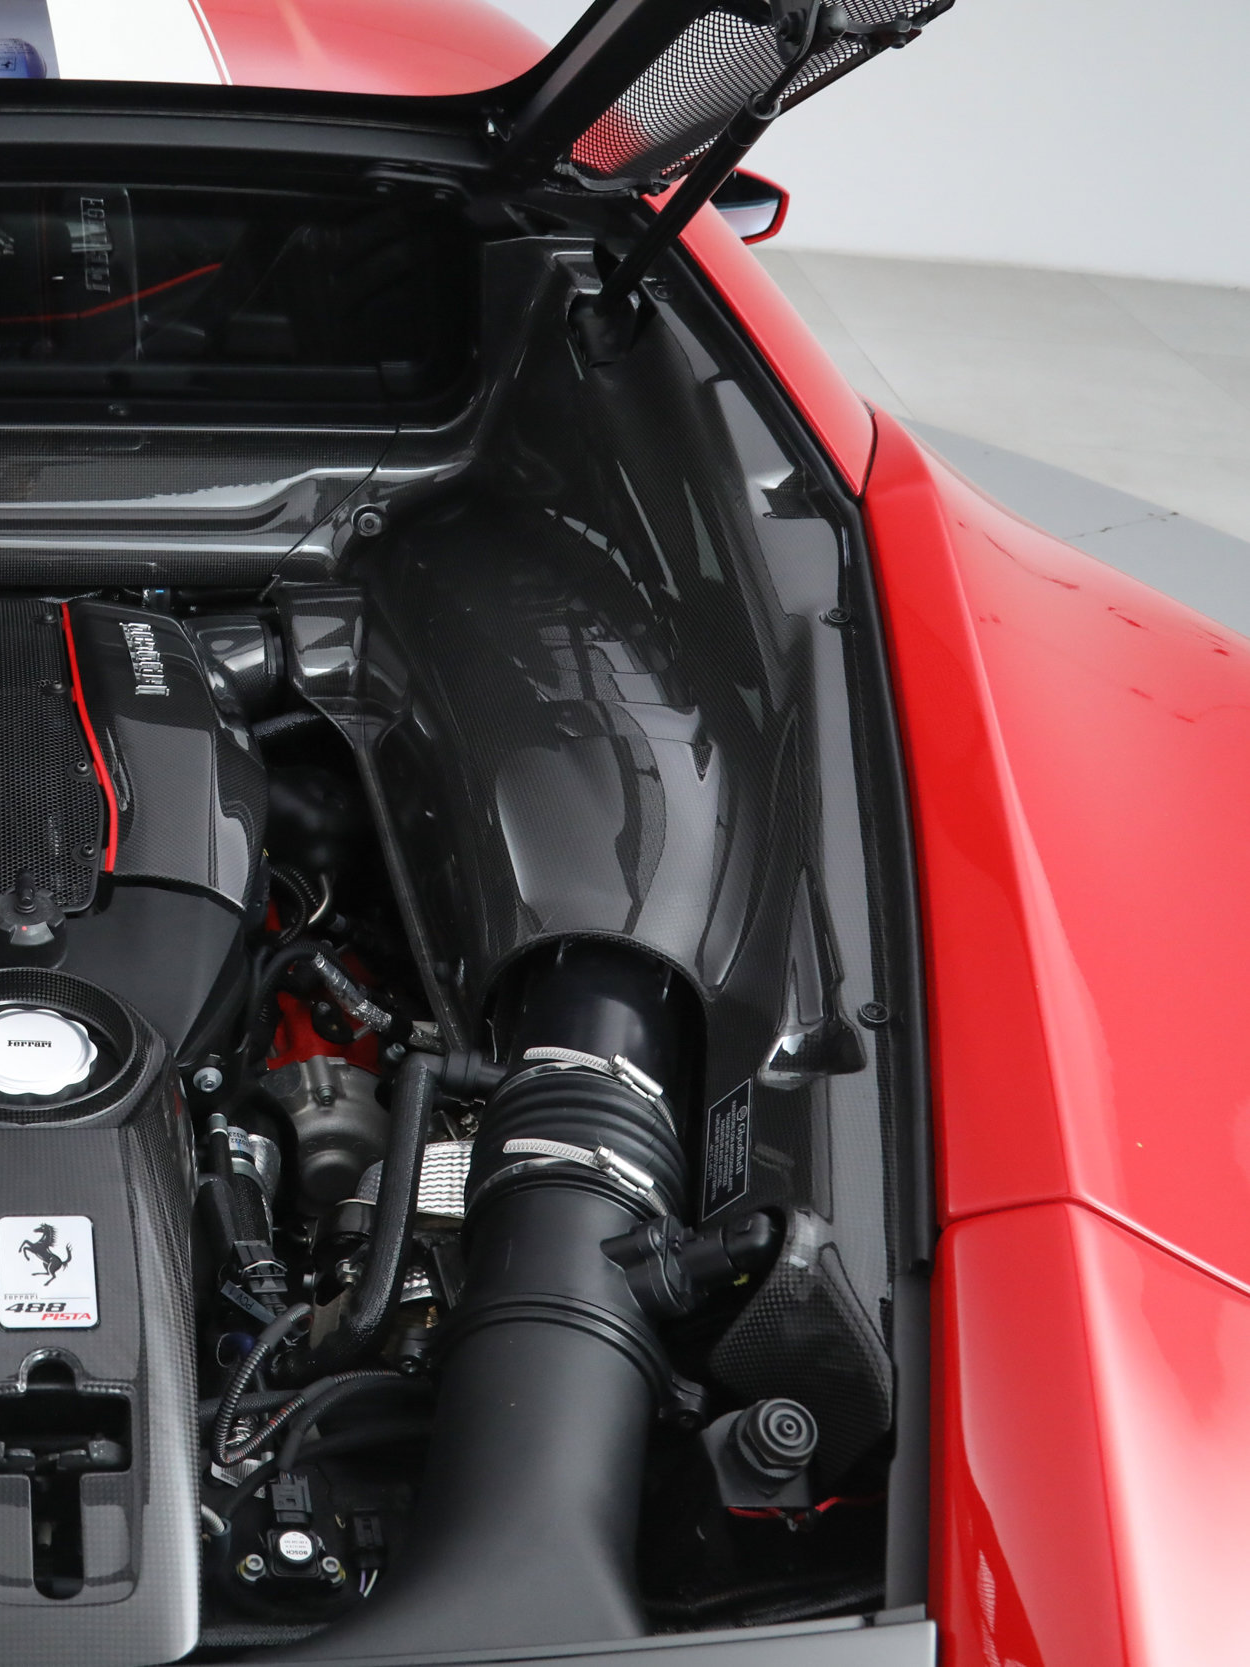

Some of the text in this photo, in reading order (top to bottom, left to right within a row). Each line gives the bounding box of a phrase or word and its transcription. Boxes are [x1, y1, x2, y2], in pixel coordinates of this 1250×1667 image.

[7, 1039, 52, 1048] Ferrari
[736, 1123, 746, 1175] GlycoShell
[3, 1292, 38, 1300] Ferrari
[5, 1302, 66, 1313] 488
[41, 1312, 91, 1321] PISTA
